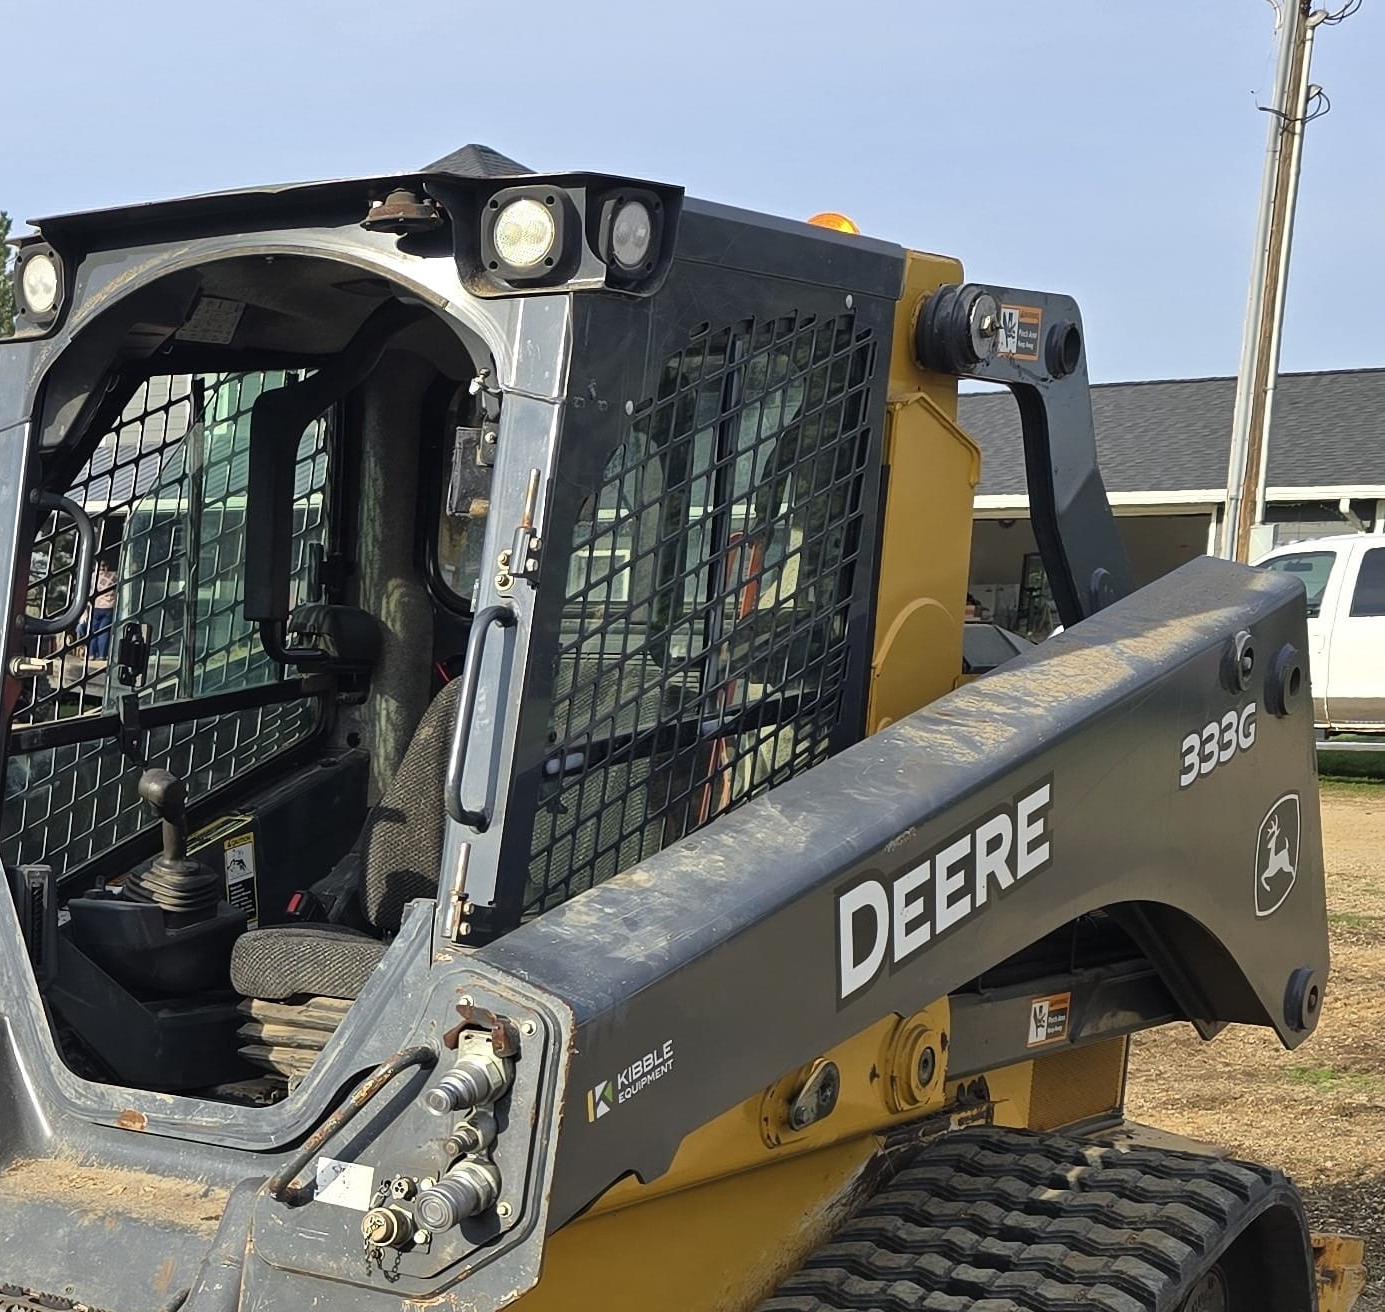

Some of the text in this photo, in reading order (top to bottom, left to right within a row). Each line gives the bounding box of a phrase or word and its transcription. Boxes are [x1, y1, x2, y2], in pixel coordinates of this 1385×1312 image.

[1180, 702, 1256, 787] 333G
[839, 783, 1050, 1000] DEERE
[617, 1039, 674, 1090] KIBBLE
[618, 1058, 674, 1104] EQUIPMENT
